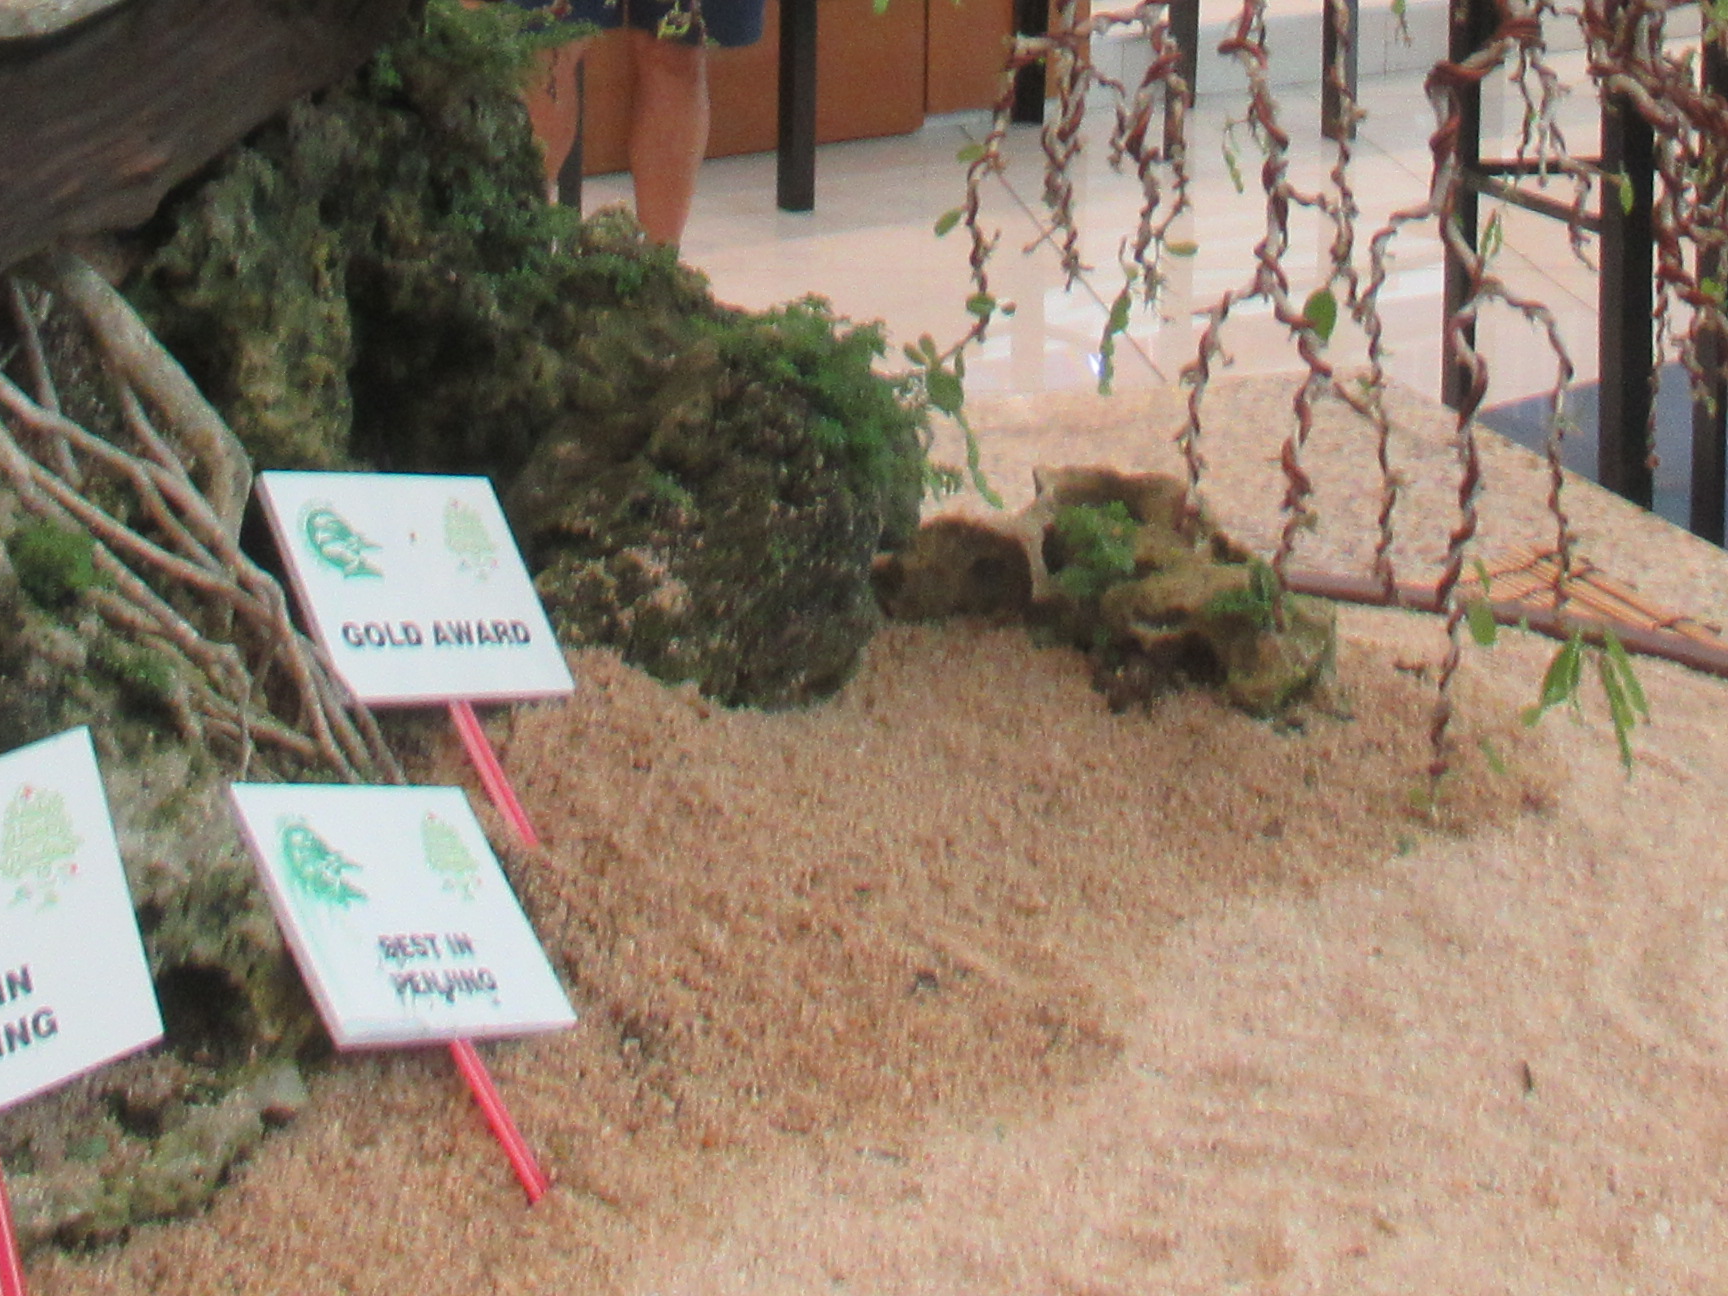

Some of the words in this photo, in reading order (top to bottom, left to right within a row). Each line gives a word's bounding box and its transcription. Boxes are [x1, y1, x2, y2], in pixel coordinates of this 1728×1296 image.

[341, 619, 423, 648] GOLD
[432, 618, 531, 646] AWARD
[377, 932, 441, 959] BEST
[445, 932, 474, 955] IN
